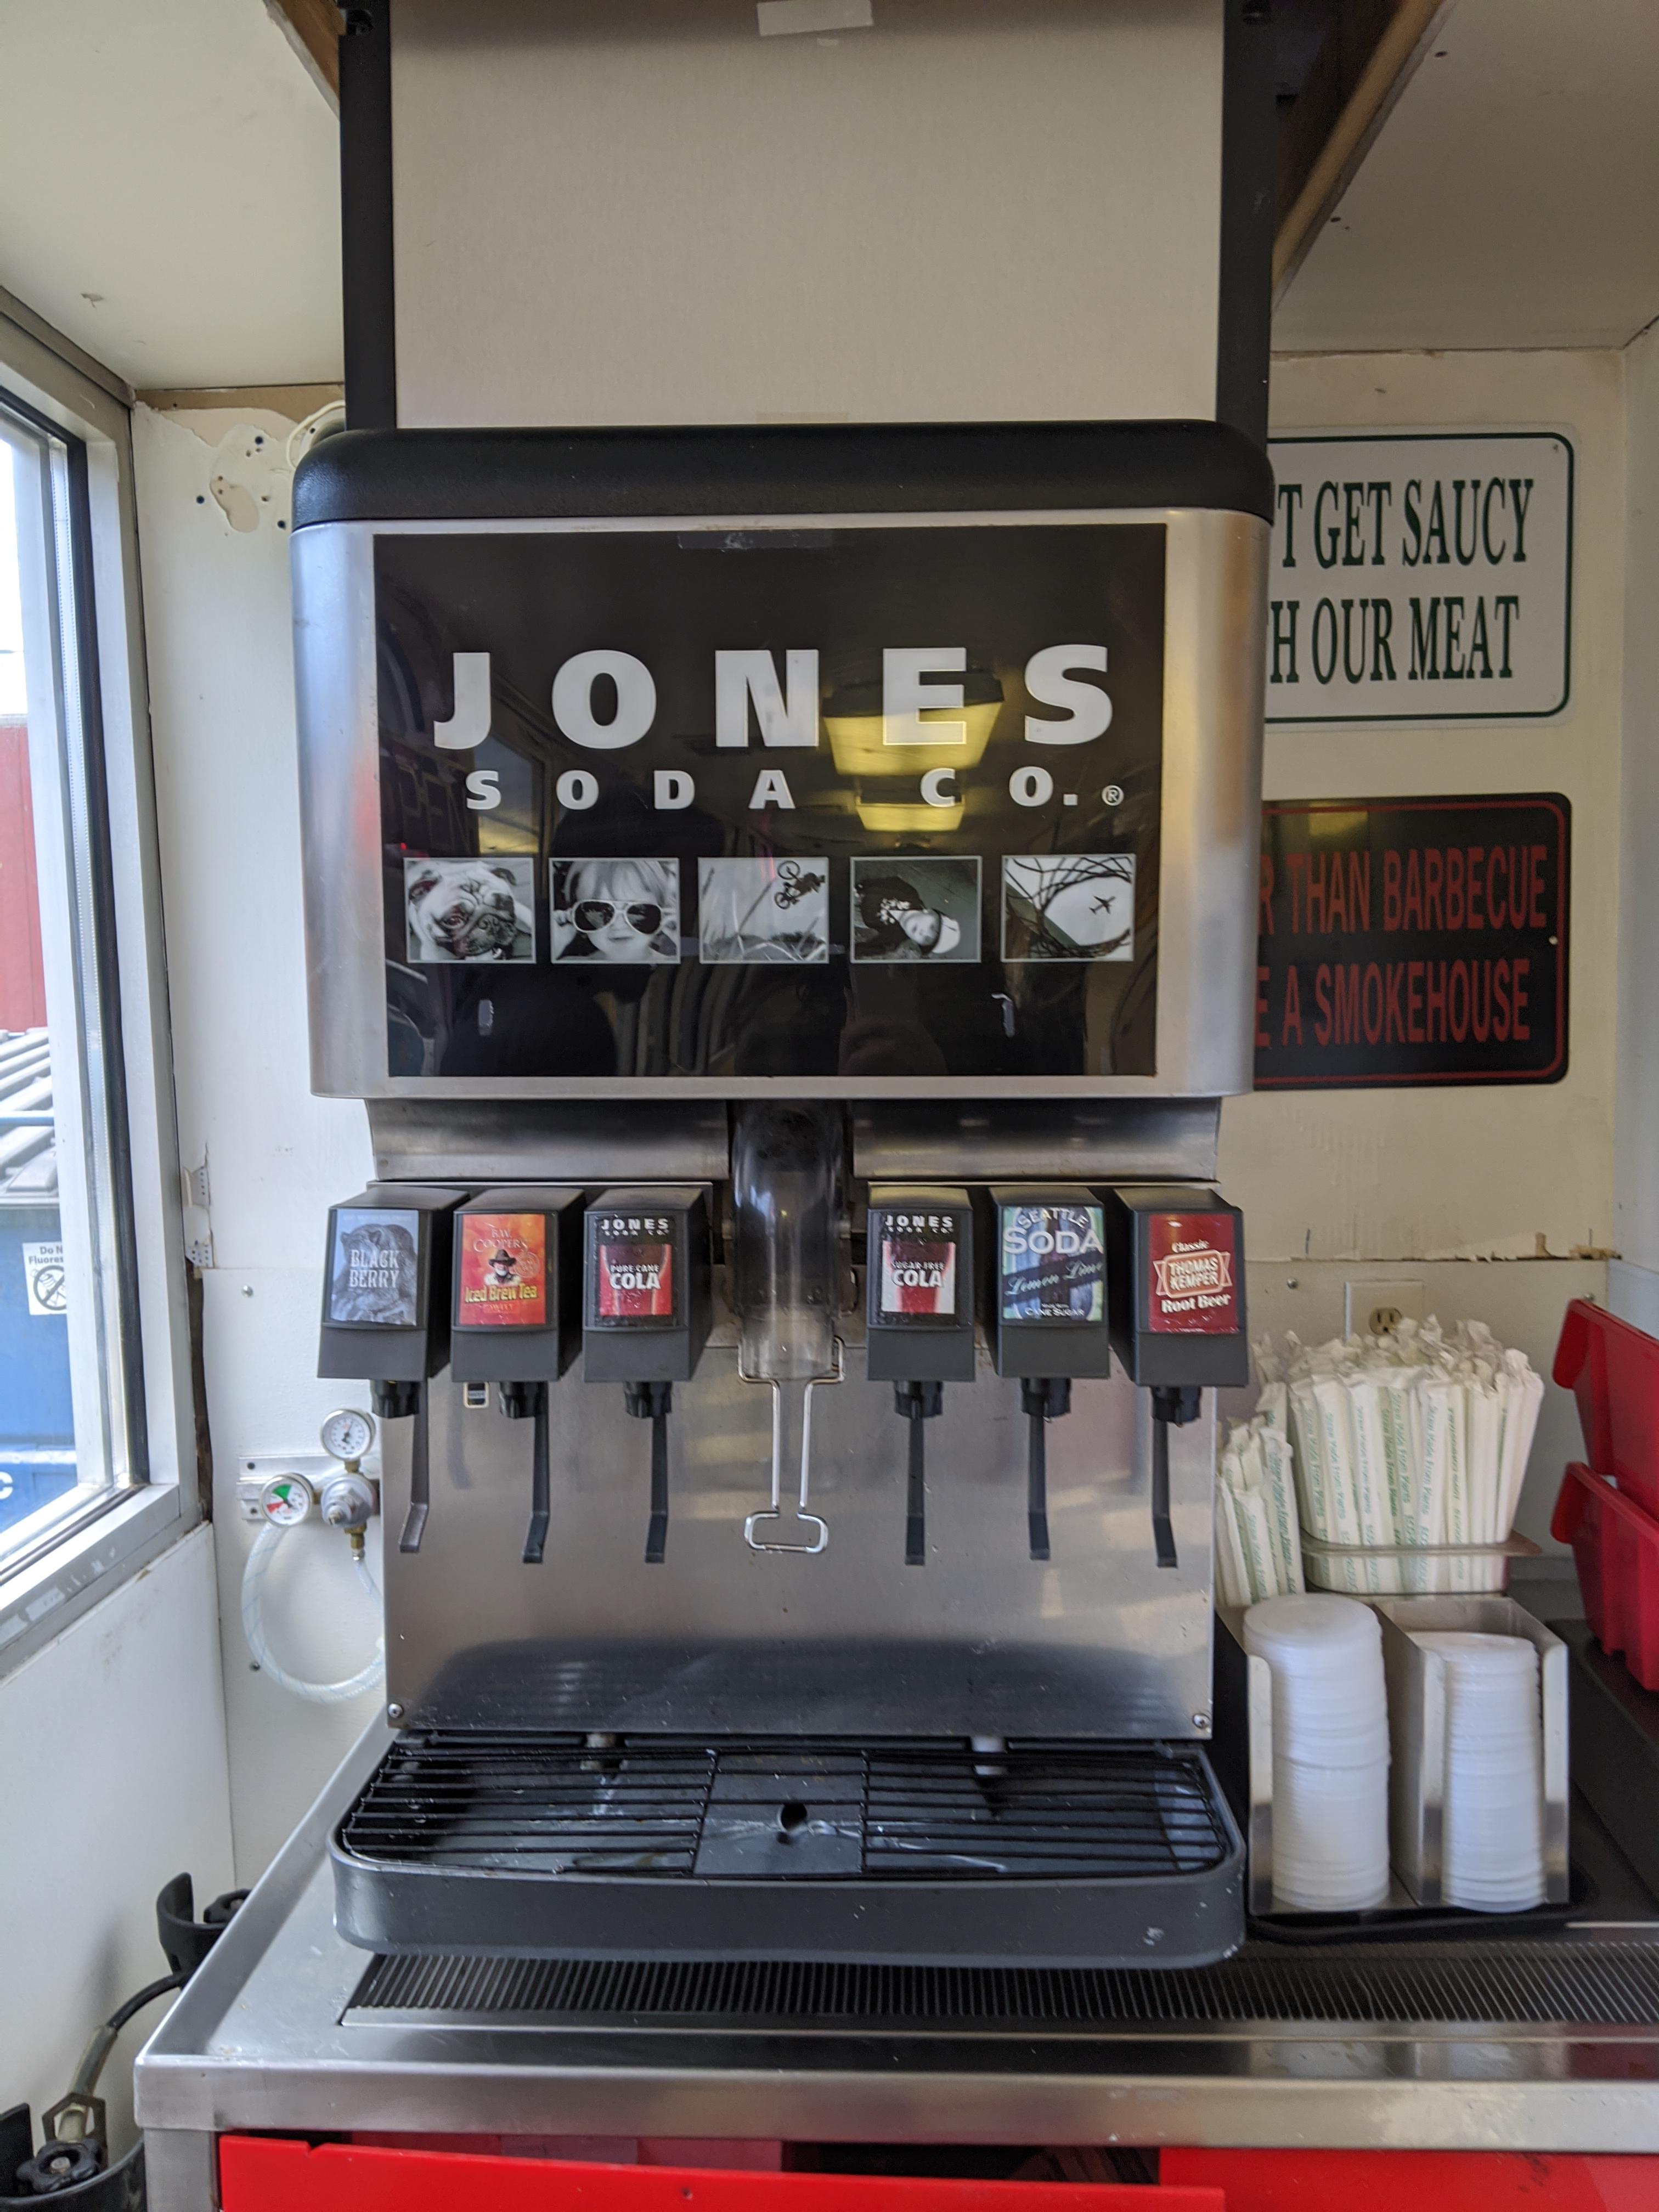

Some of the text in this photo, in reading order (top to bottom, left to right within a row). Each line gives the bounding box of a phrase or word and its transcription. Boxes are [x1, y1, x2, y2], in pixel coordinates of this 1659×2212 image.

[1314, 481, 1392, 569] GET
[1402, 477, 1534, 567] SAUCY
[1312, 597, 1397, 685] OUR
[1408, 595, 1520, 680] MEAT
[433, 644, 1113, 750] JONES
[465, 769, 795, 811] SODA
[1285, 850, 1370, 934] THAN
[1383, 845, 1548, 932] BARBECUE
[1282, 964, 1304, 1046] A
[1314, 958, 1531, 1047] SMOKEHOUSE
[601, 1218, 669, 1230] JONES
[885, 1215, 953, 1227] JONES
[1018, 1207, 1089, 1229] SEATTLE
[40, 1245, 54, 1255] Do
[1003, 1227, 1104, 1254] SODA
[1171, 1239, 1210, 1253] Classic
[351, 1249, 400, 1268] BLACK
[1167, 1257, 1219, 1277] THOMAS
[349, 1269, 400, 1288] BERRY
[610, 1272, 661, 1290] COLA
[892, 1269, 944, 1288] COLA
[1005, 1274, 1060, 1296] Lemon
[1169, 1271, 1220, 1291] KEMPER
[465, 1282, 538, 1303] Iced Brew Tea
[1161, 1294, 1232, 1314] Root Beer
